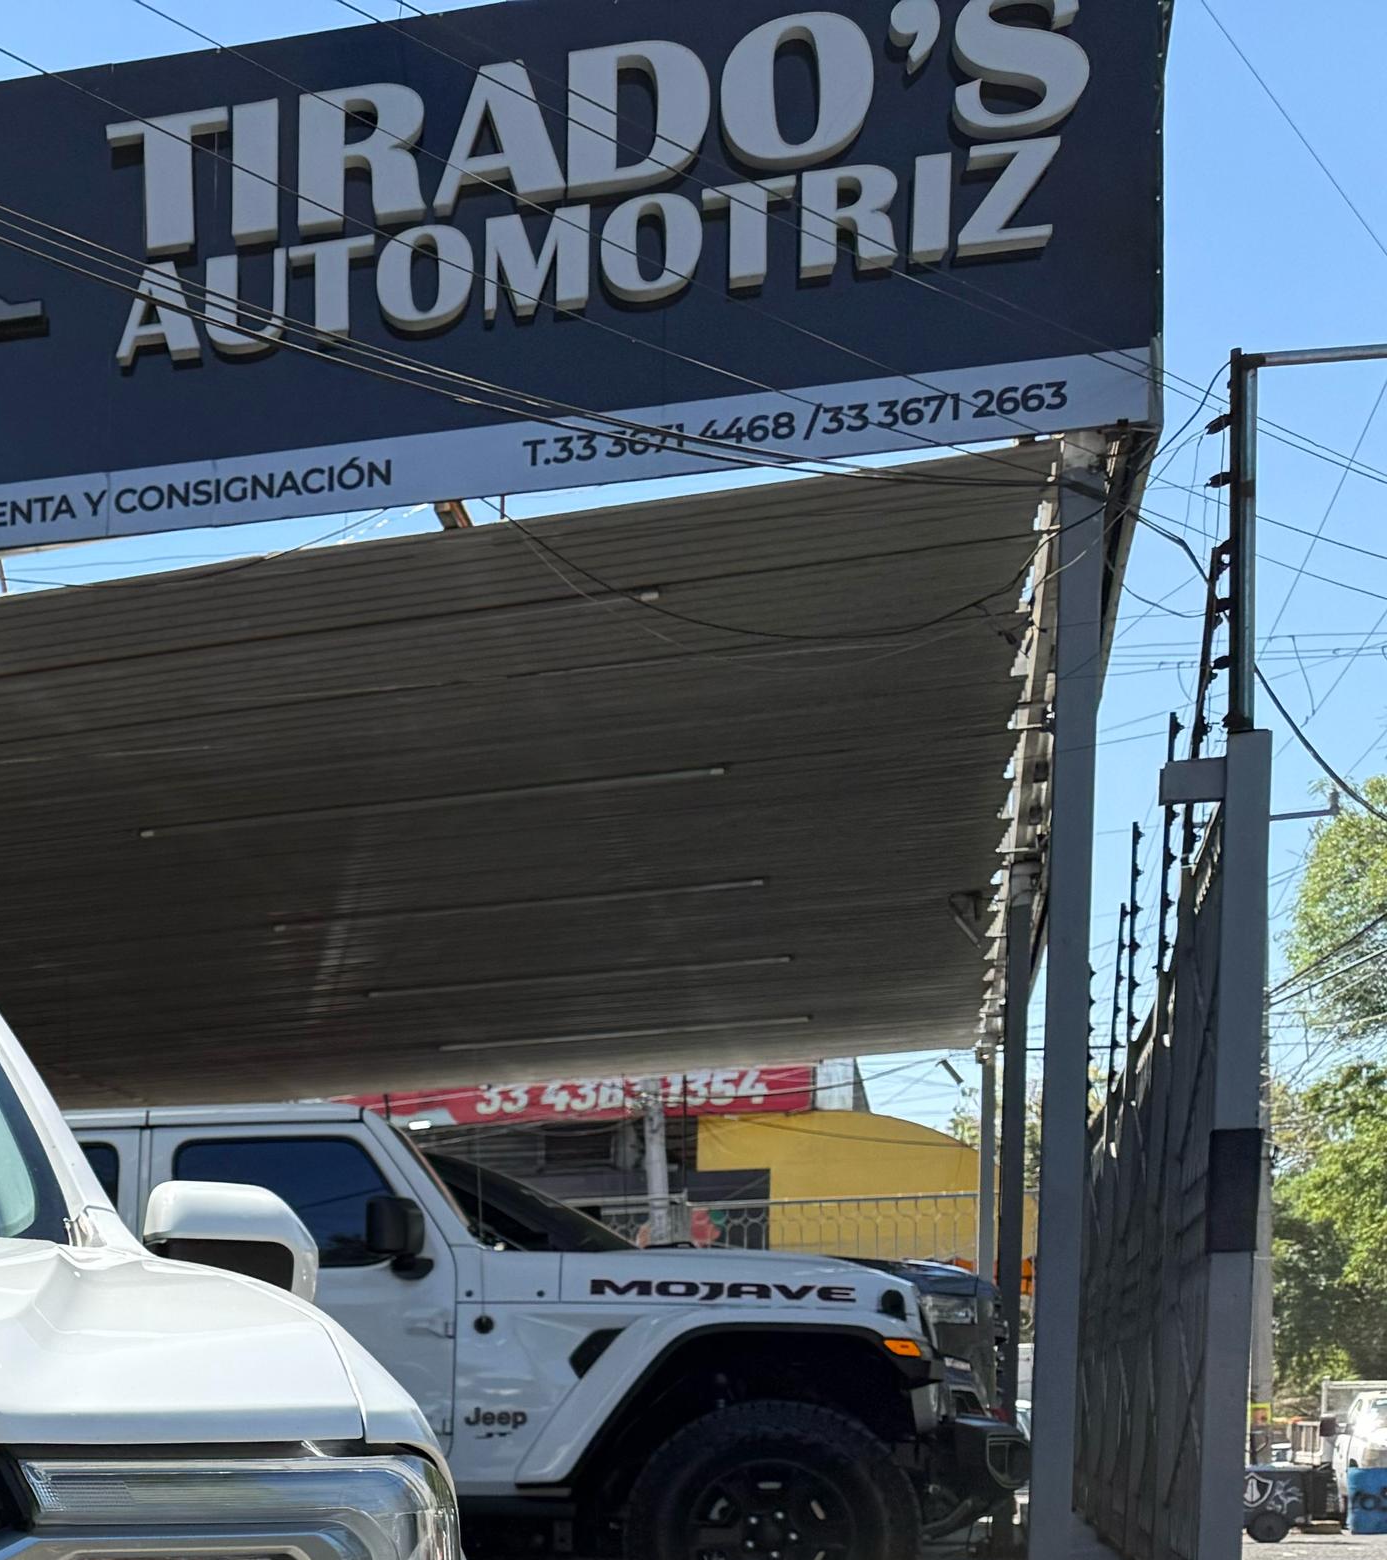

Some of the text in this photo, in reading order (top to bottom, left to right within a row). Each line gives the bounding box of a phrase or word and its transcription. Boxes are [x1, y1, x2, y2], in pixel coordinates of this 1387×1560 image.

[106, 0, 1090, 256] TIRADO'S
[116, 136, 1062, 367] AUTOMOTRIZ
[877, 393, 960, 428] 3671
[972, 381, 1067, 418] 2663
[82, 488, 109, 516] Y
[114, 456, 393, 514] CONSIGNACIÓN
[476, 1083, 530, 1115] 33
[590, 1279, 857, 1303] MOJAVE
[464, 1406, 528, 1430] Jeep
